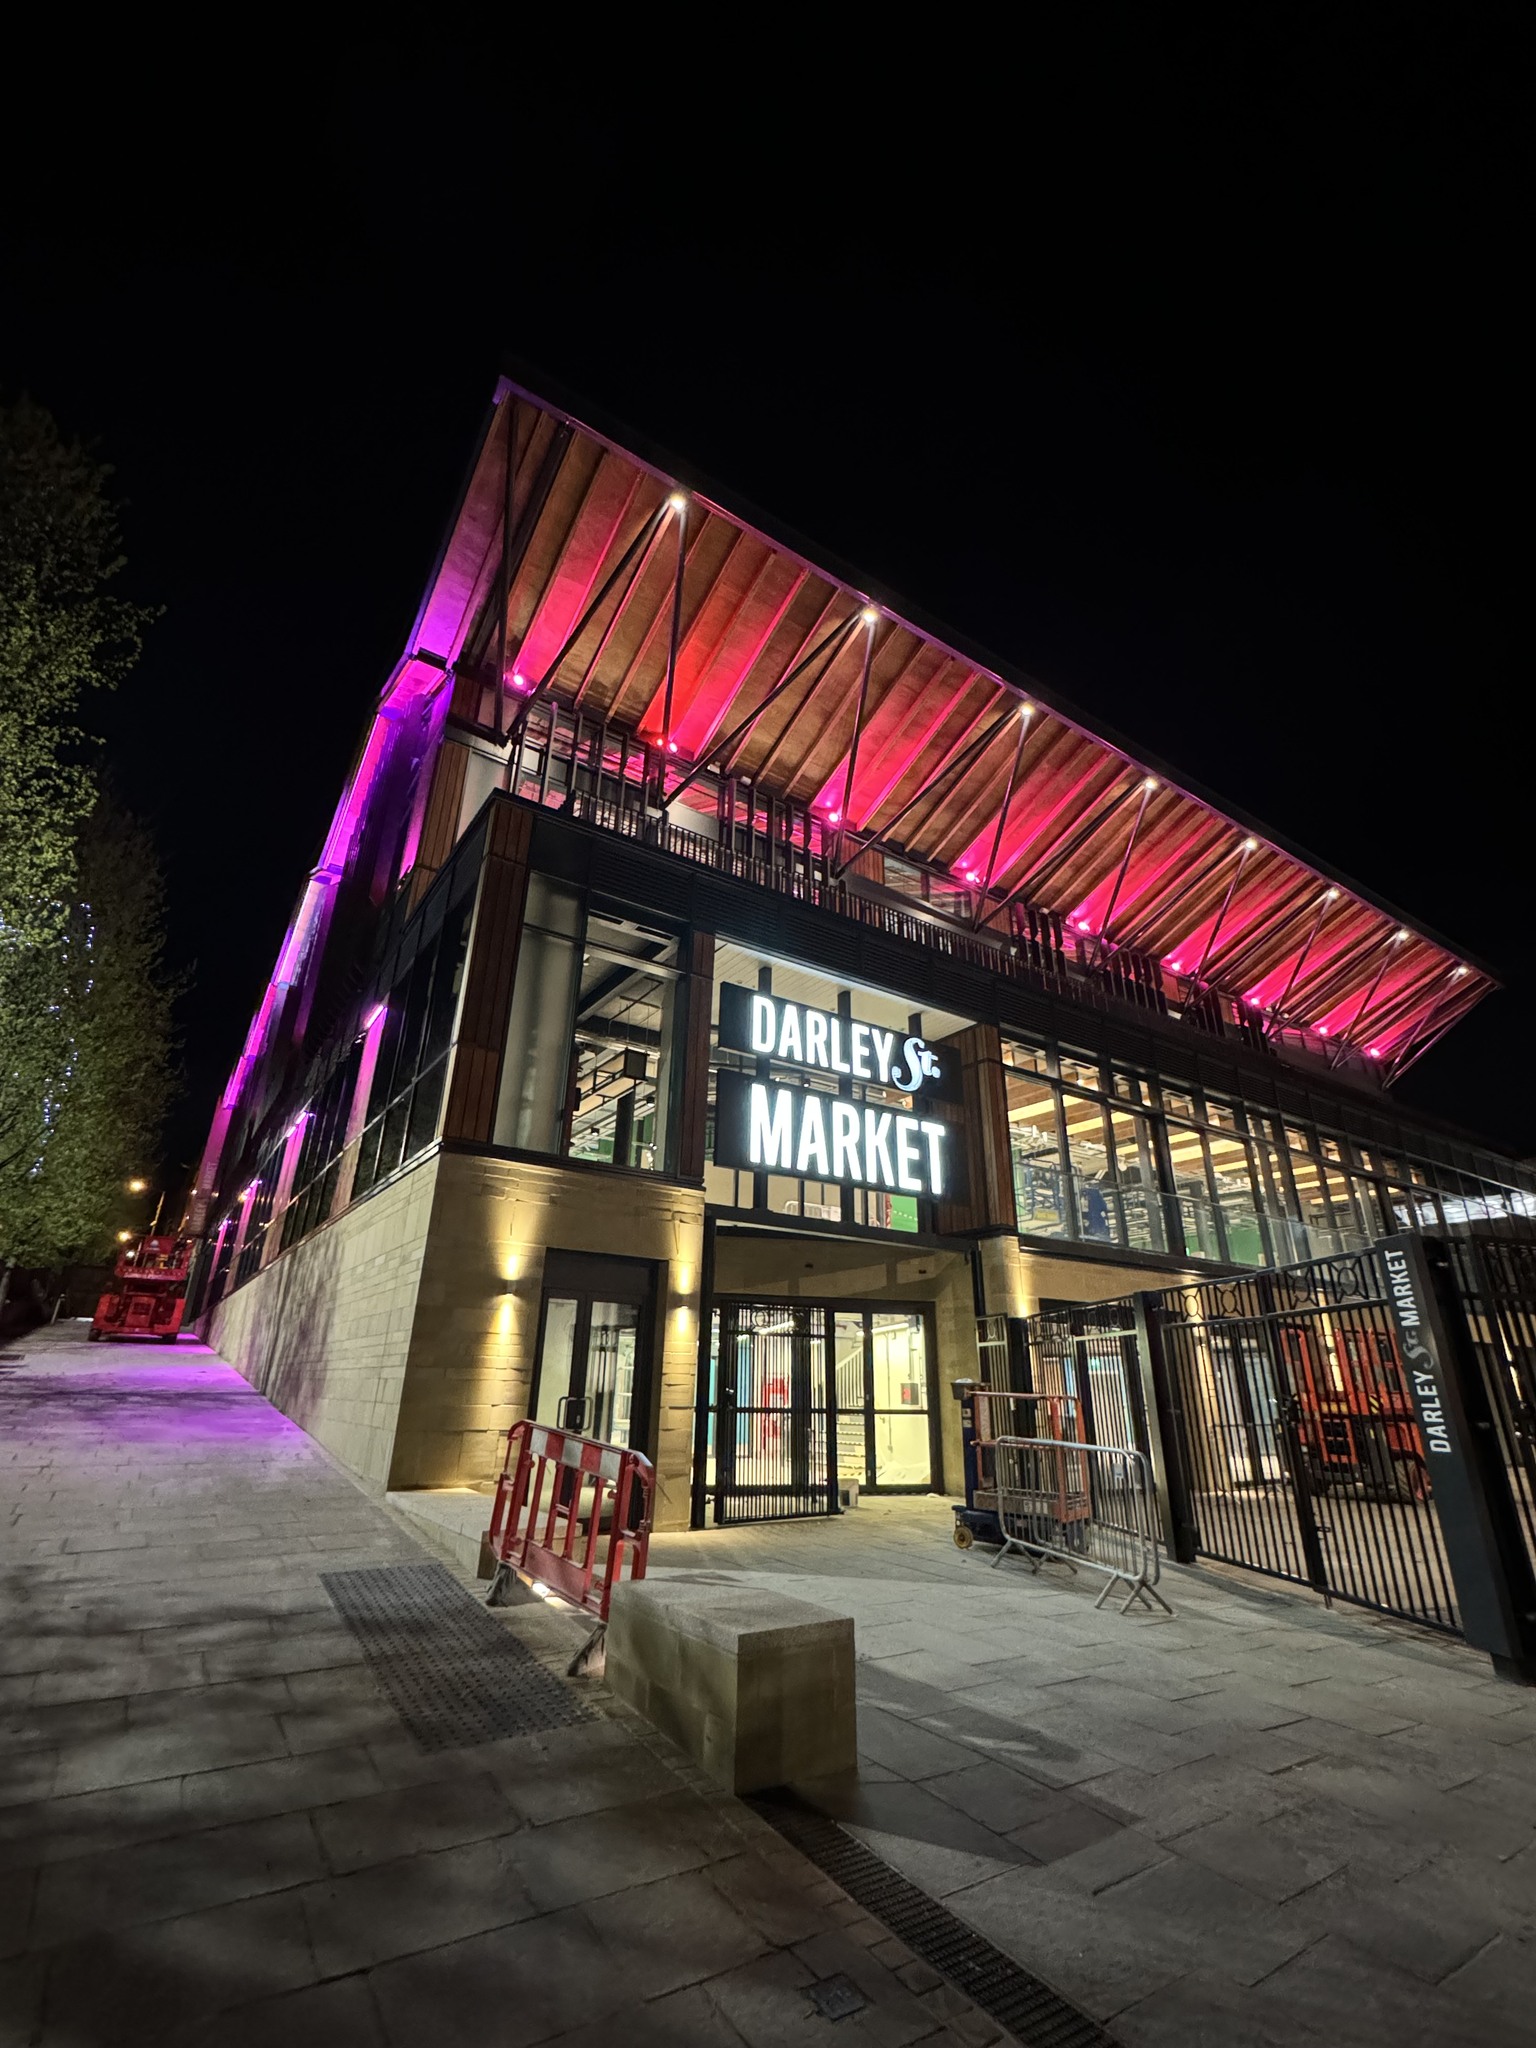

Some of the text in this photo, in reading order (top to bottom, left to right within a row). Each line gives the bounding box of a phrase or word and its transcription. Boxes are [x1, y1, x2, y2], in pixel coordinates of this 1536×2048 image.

[752, 996, 894, 1083] DARLEY
[749, 1083, 946, 1195] MARKET
[1384, 1250, 1420, 1327] MARKET
[1412, 1371, 1452, 1453] DARLEY
